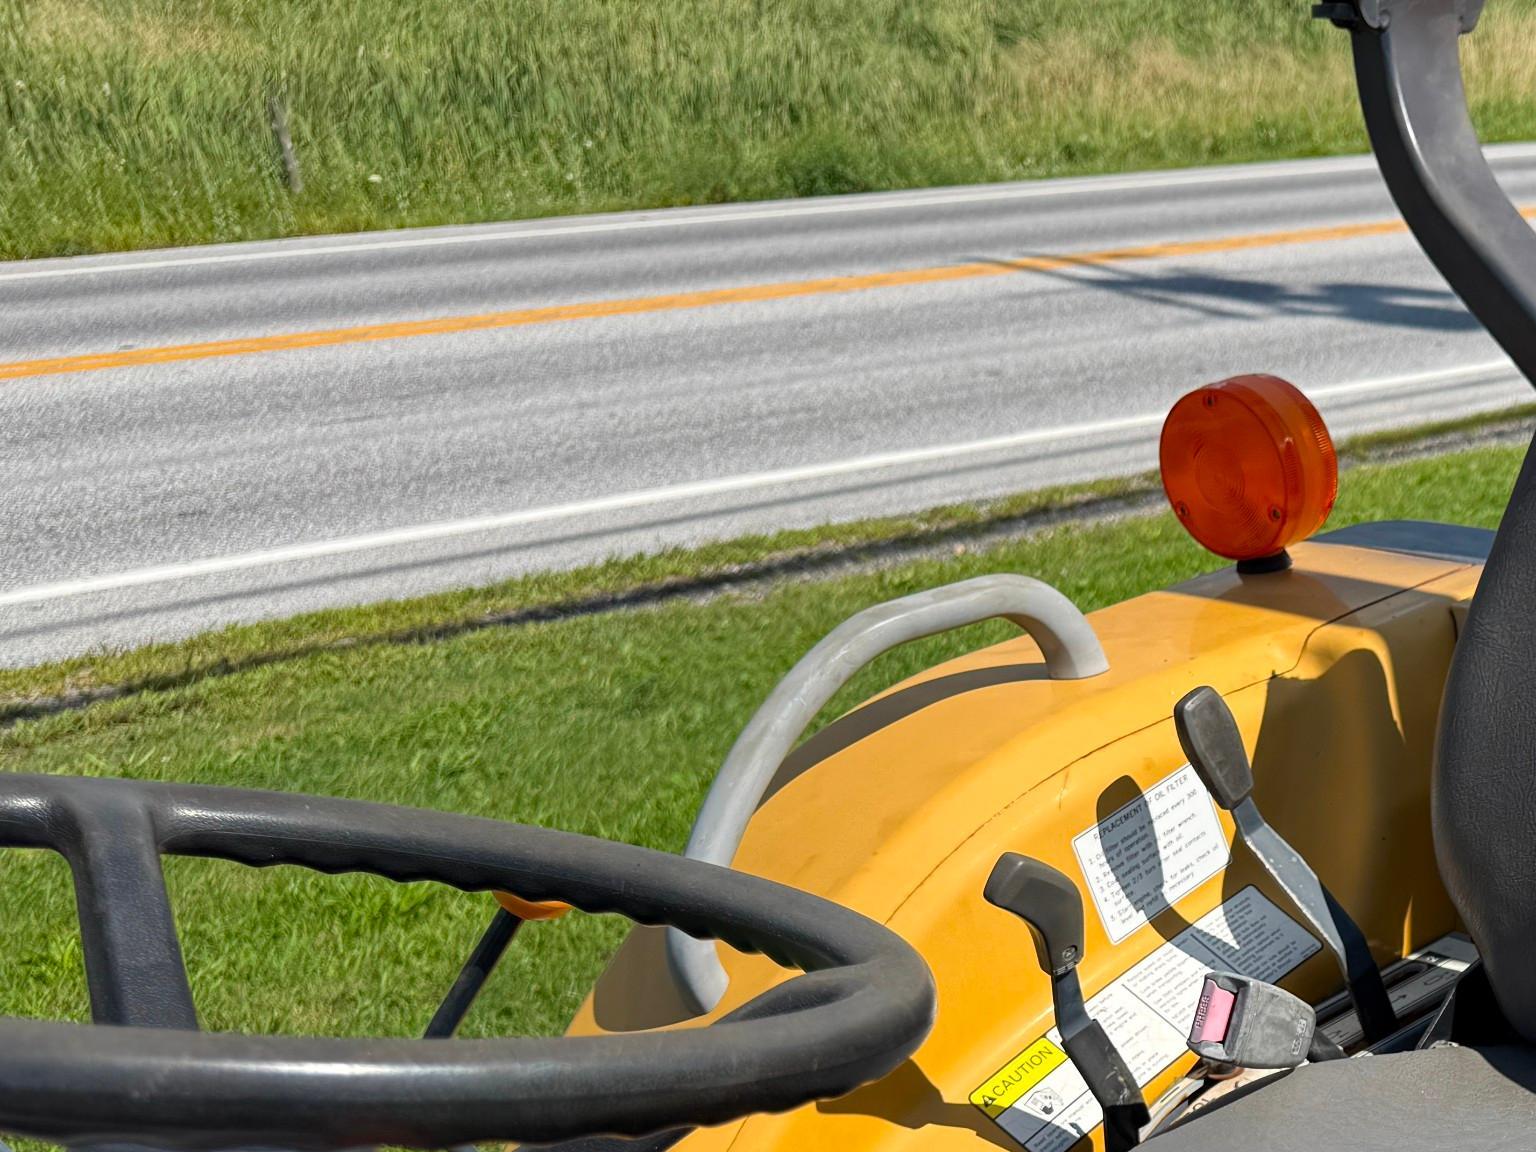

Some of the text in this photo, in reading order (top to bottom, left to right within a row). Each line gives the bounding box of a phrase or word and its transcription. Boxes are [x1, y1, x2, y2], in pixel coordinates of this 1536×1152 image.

[1093, 802, 1143, 842] REPLACEMENT
[1165, 773, 1188, 793] FILTER
[1194, 994, 1211, 1029] PRESS
[991, 1045, 1053, 1097] CAUTION
